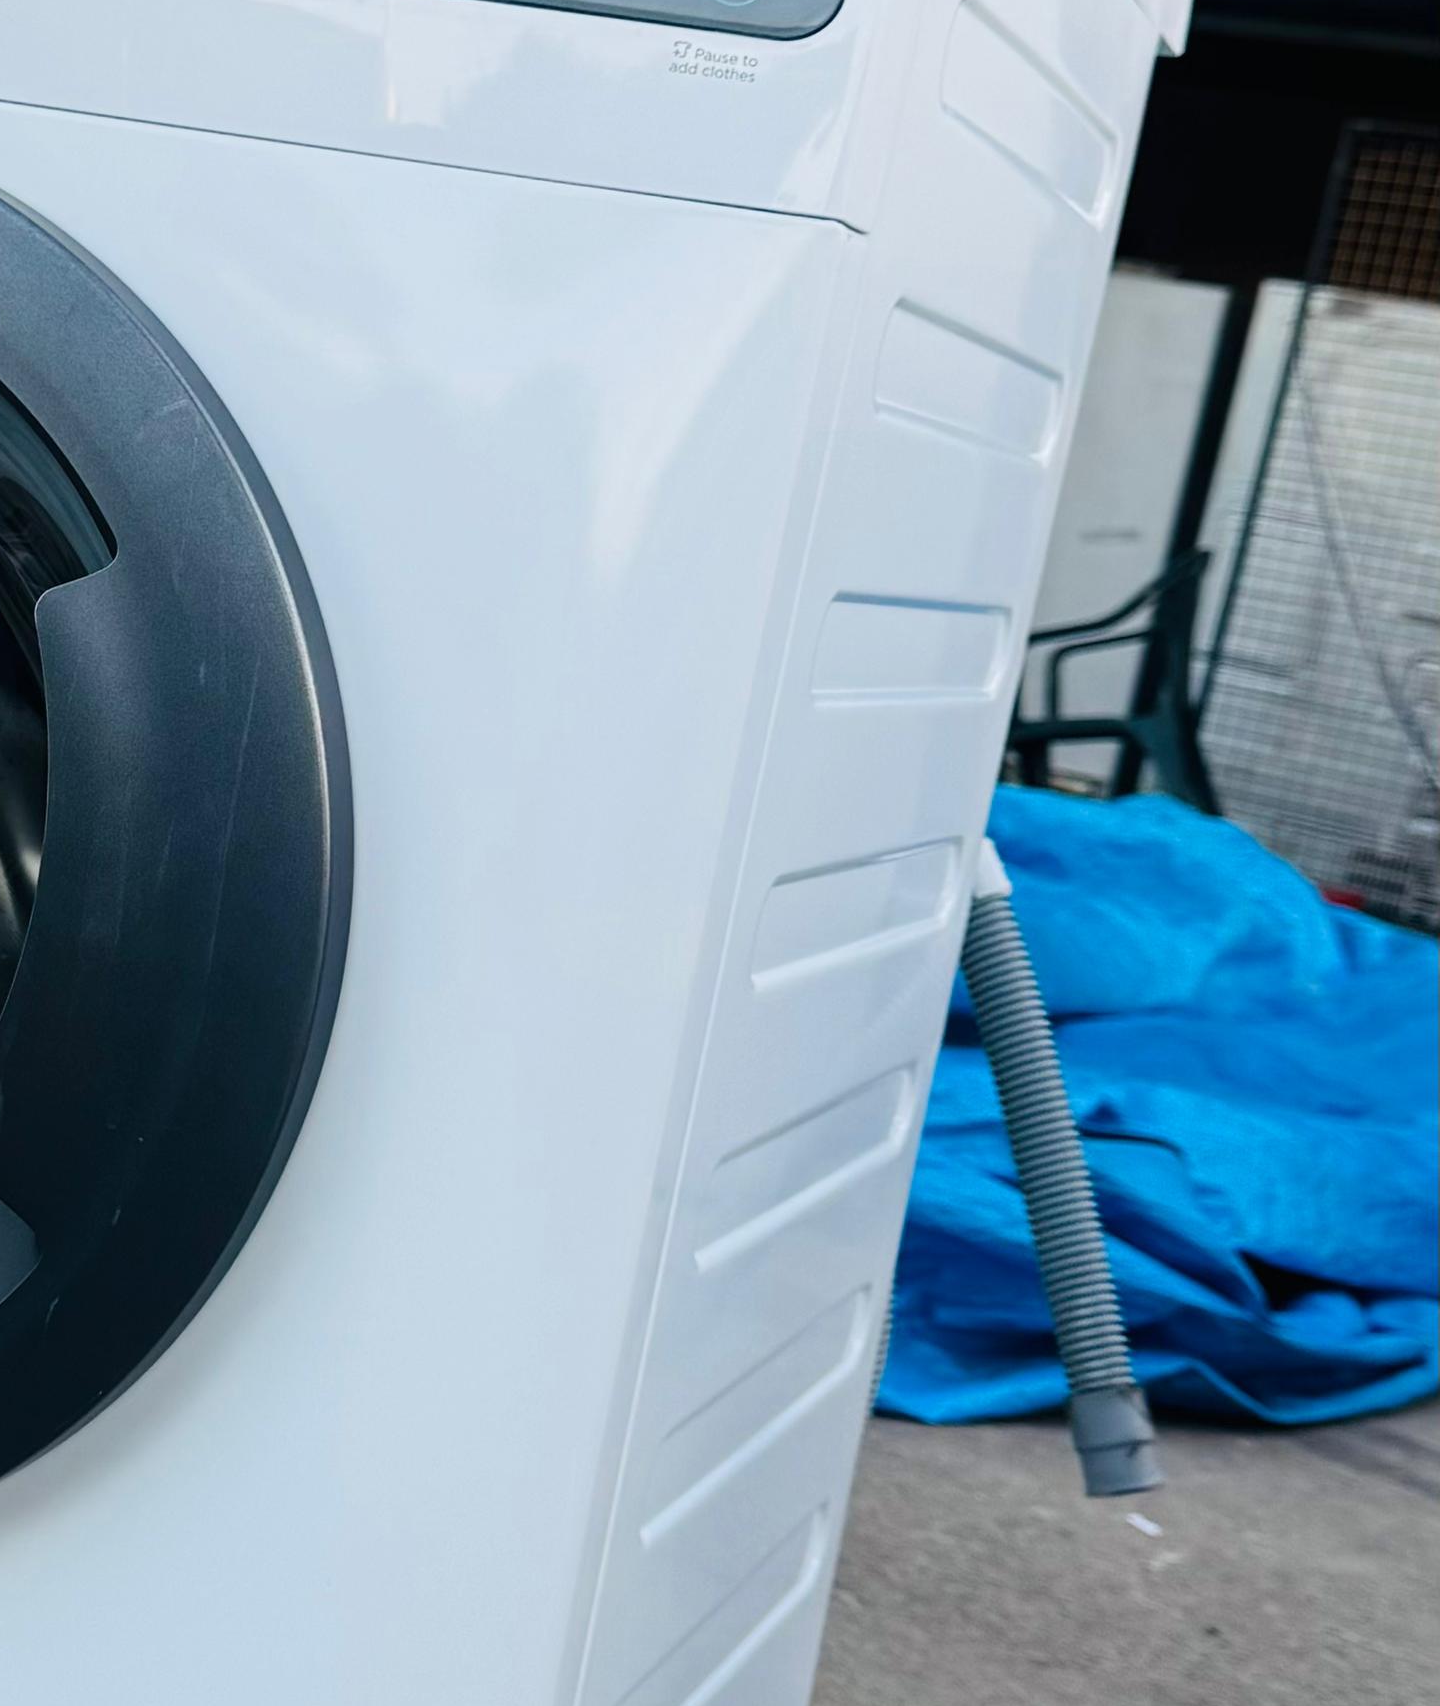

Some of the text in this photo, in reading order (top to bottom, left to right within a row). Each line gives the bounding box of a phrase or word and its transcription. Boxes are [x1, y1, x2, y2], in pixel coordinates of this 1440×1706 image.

[694, 47, 758, 68] Pause to
[668, 61, 756, 83] add clothes
